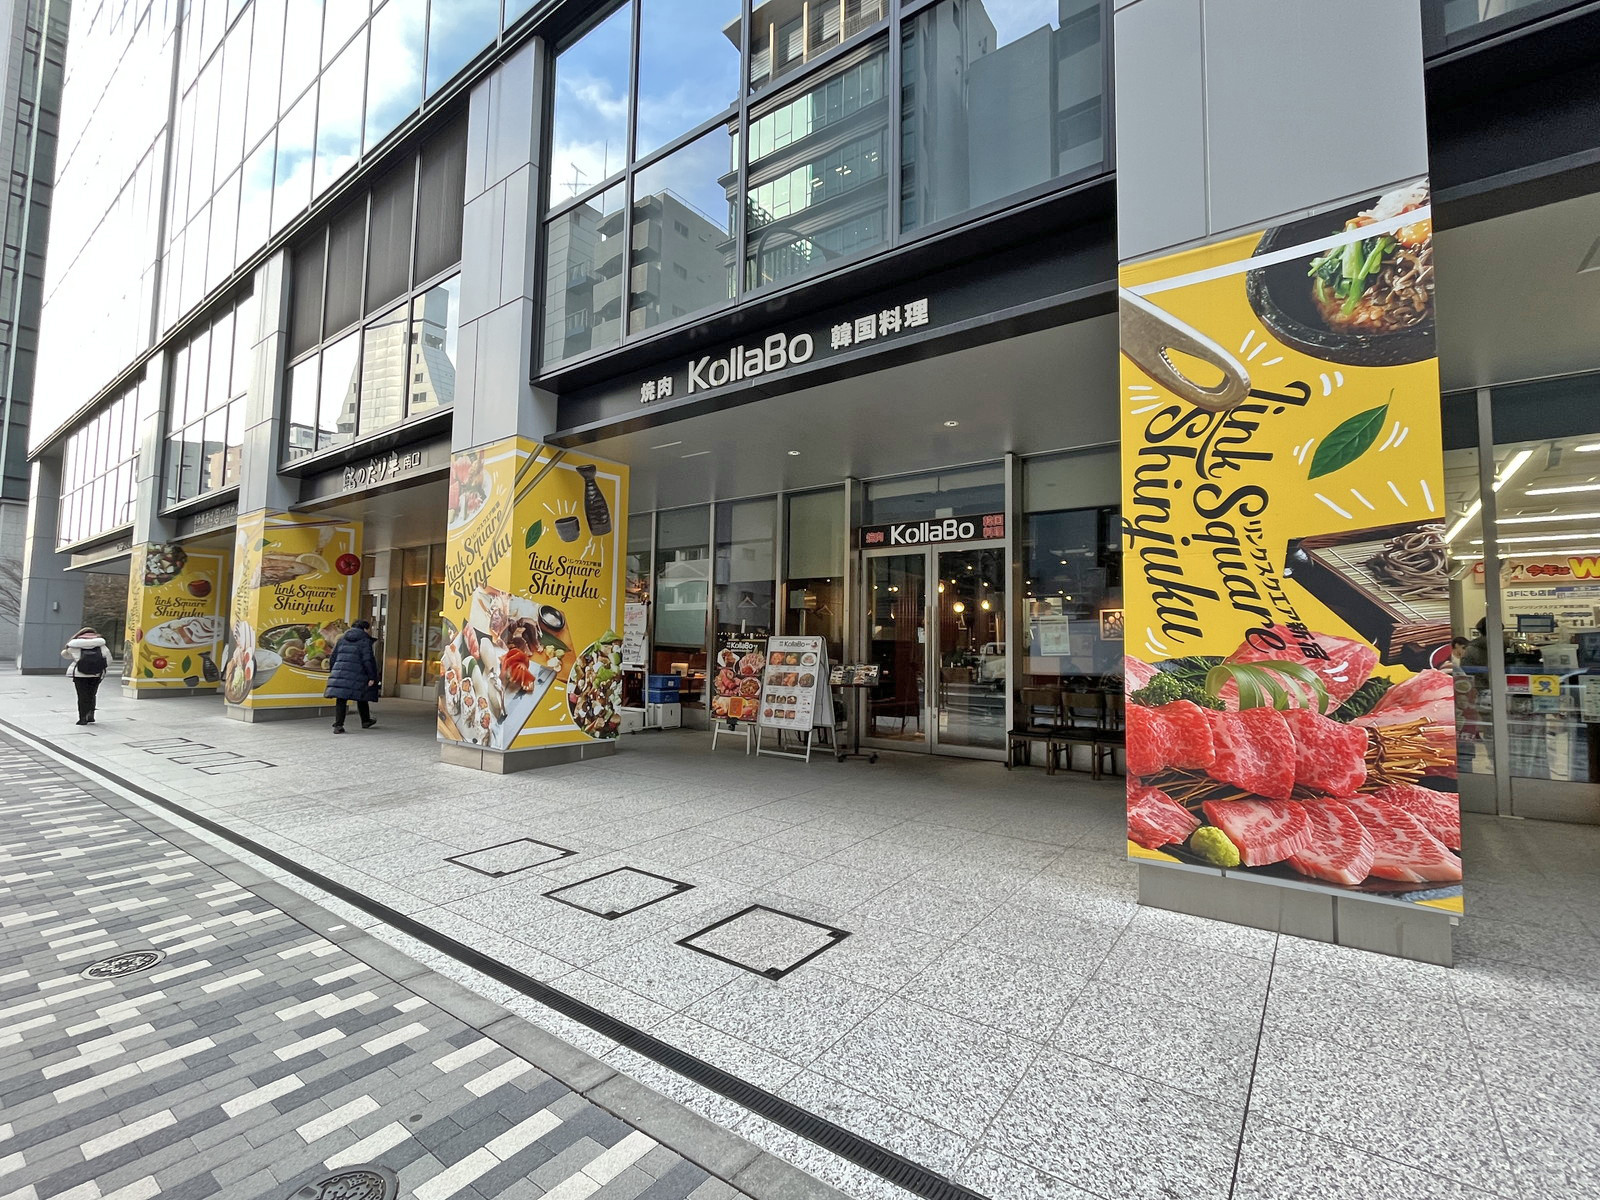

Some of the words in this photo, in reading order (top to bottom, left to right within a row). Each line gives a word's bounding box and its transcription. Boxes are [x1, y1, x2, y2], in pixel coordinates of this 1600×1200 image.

[640, 376, 673, 403] 焼肉
[687, 332, 814, 393] KollaBo
[830, 298, 929, 350] 韓国料理
[1195, 381, 1311, 480] Link
[404, 451, 421, 470] 南口
[464, 510, 502, 566] Square
[890, 519, 975, 545] KollaBo
[1121, 405, 1220, 644] Shinjuku
[453, 533, 512, 610] Shinjuku
[528, 552, 554, 575] Link
[555, 556, 602, 580] Square
[1193, 484, 1286, 653] Square
[273, 595, 335, 615] Shinjuku
[274, 583, 295, 597] Link
[296, 584, 337, 599] Square
[528, 573, 600, 603] Shinjuku
[1244, 520, 1331, 661] リンクスクエア新宿
[154, 605, 204, 620] Shinjuku
